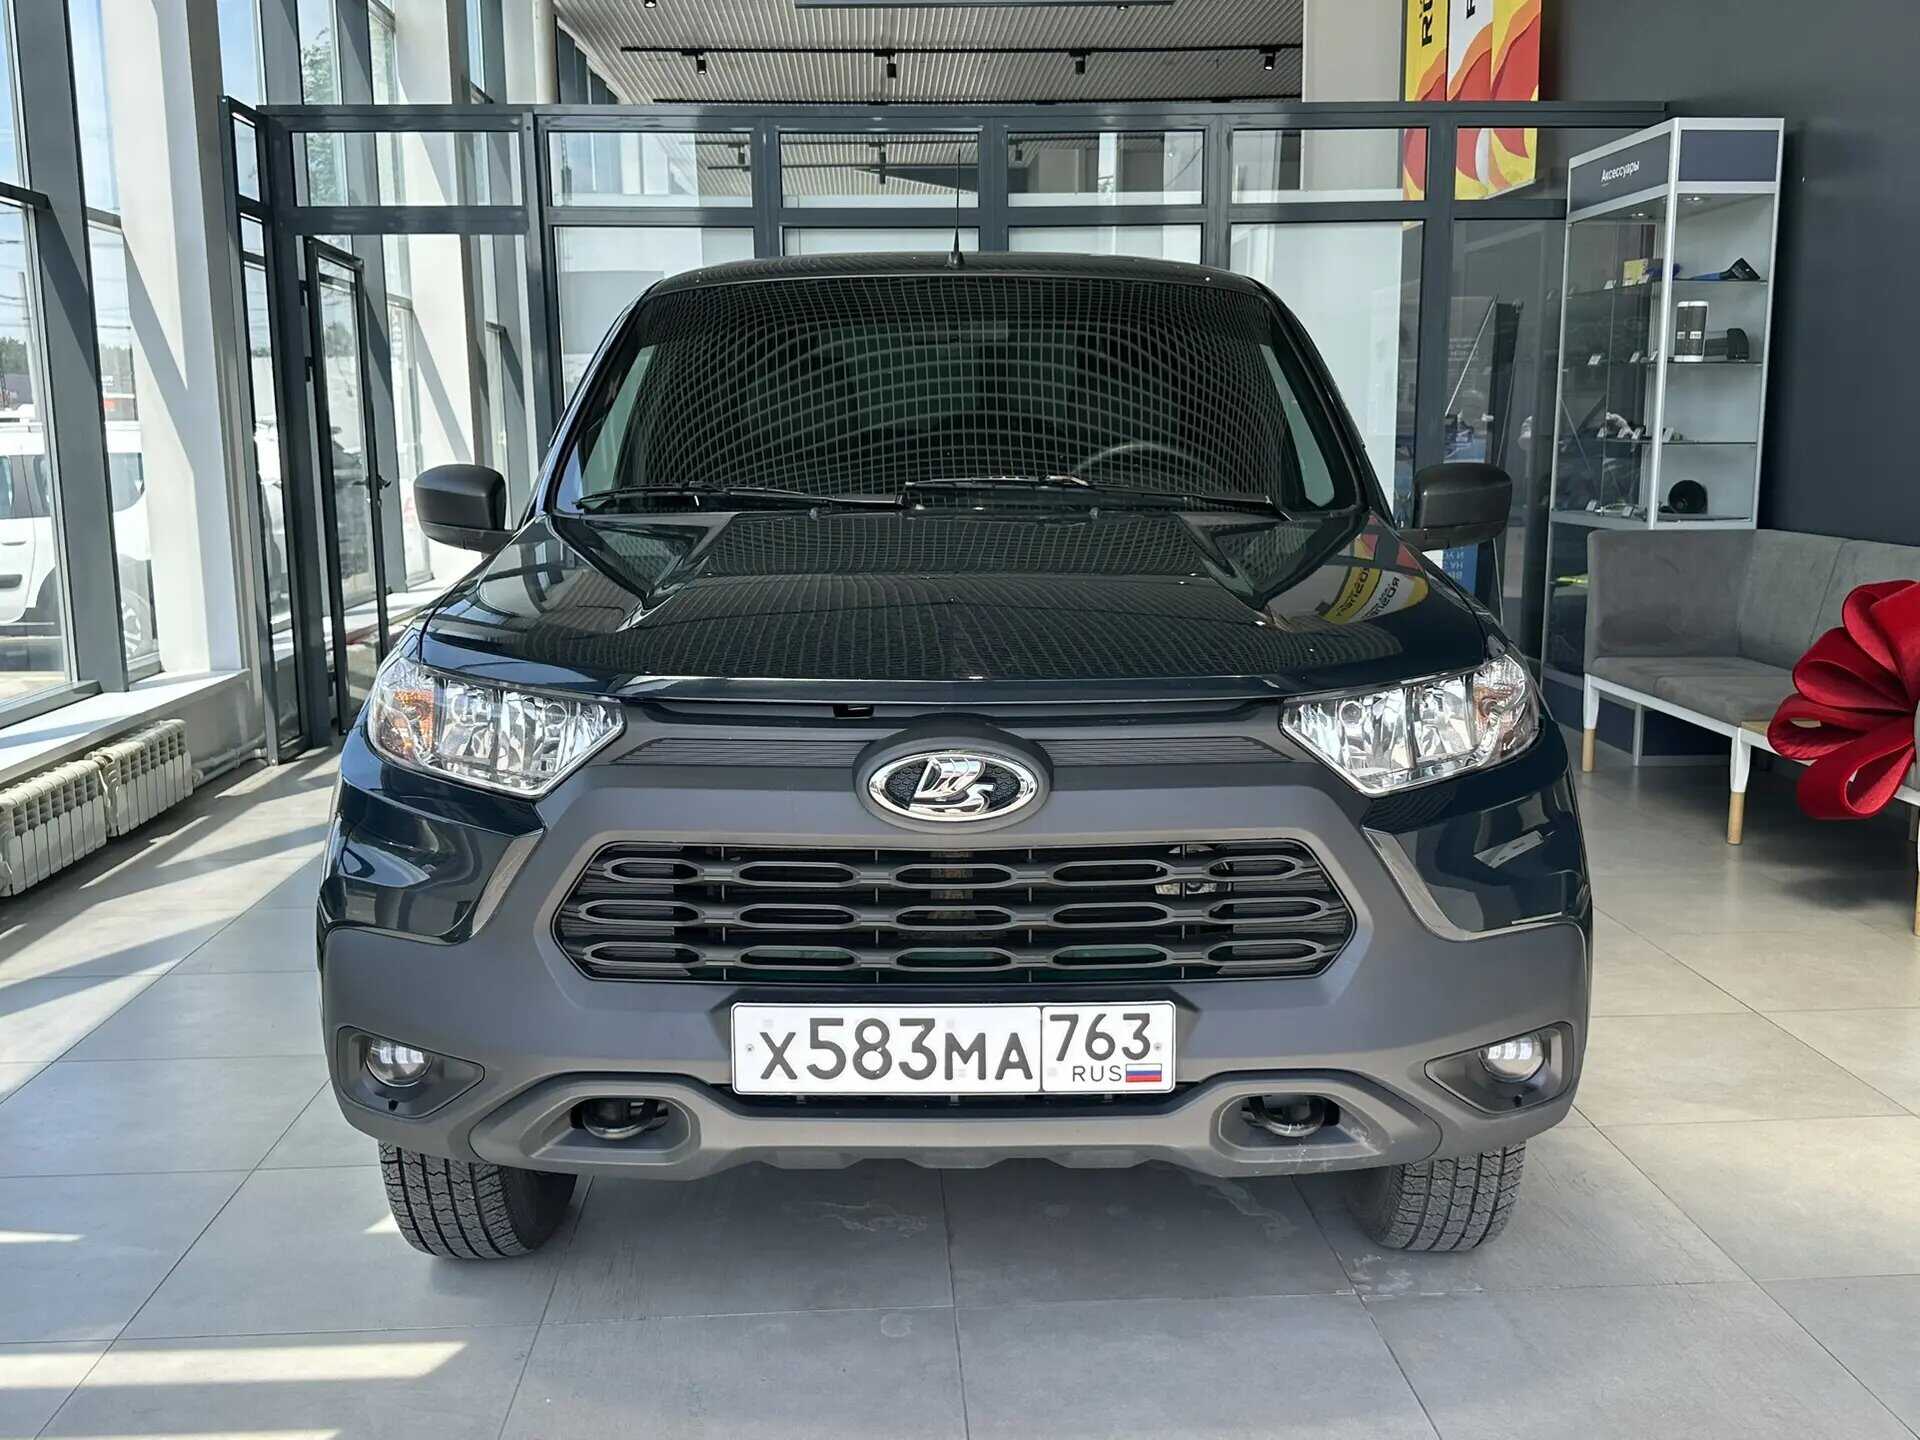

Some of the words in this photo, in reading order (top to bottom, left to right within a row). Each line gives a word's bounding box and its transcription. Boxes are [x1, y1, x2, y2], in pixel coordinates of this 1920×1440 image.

[1601, 161, 1640, 182] Аксессуары
[759, 1017, 1033, 1081] Х583МА
[1049, 1012, 1151, 1061] 763
[1072, 1064, 1122, 1083] RUS
